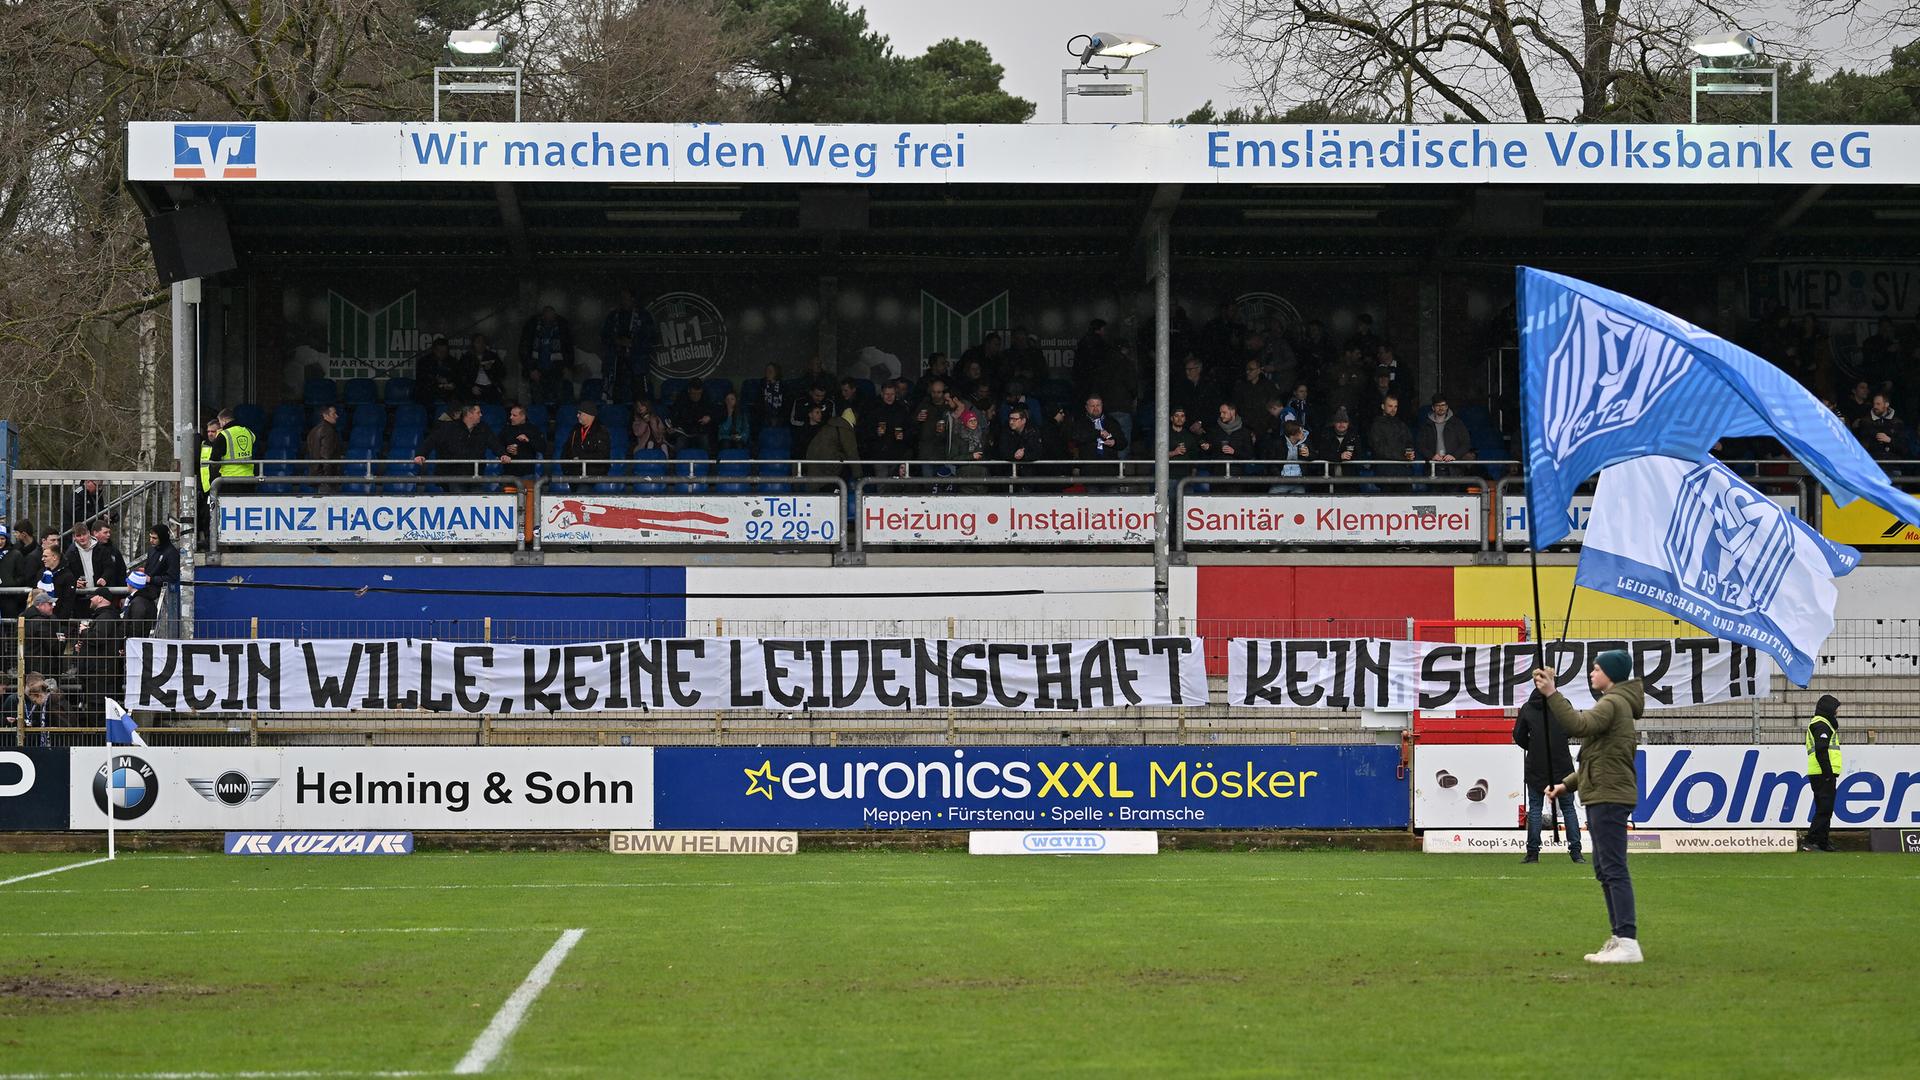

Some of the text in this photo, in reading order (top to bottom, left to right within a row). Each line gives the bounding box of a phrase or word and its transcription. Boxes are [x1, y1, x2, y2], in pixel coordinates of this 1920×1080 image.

[412, 131, 966, 179] Wir machen den Weg frei
[1208, 130, 1872, 170] Emsländische Volksbank eG
[220, 505, 515, 531] HEINZ HACKMANN
[765, 498, 812, 518] Tel.:
[745, 520, 835, 541] 92 29-0
[866, 508, 1155, 536] Heizung Installation
[1187, 508, 1470, 536] Sanitär Klempnerei
[1617, 576, 1793, 666] LEIDENSCHAFT UND TRADITION
[139, 641, 281, 710] KEIN
[523, 638, 705, 713] KEINE
[730, 637, 1192, 709] LEIDENSCHAFT
[1245, 638, 1391, 711] KEIN
[218, 783, 248, 794] MINI
[297, 770, 633, 812] Helming & Sohn
[1151, 759, 1318, 798] Mösker
[1632, 749, 1920, 825] Volmer
[864, 806, 1205, 825] Meppen Fürstenau Spelle Bramsche
[274, 835, 366, 853] KUZKA
[613, 835, 793, 853] BMW HELMING
[1031, 834, 1098, 848] wavin
[1510, 836, 1571, 849] Apeken
[1675, 835, 1795, 848] www.oekothek.de
[1906, 834, 1920, 845] G
